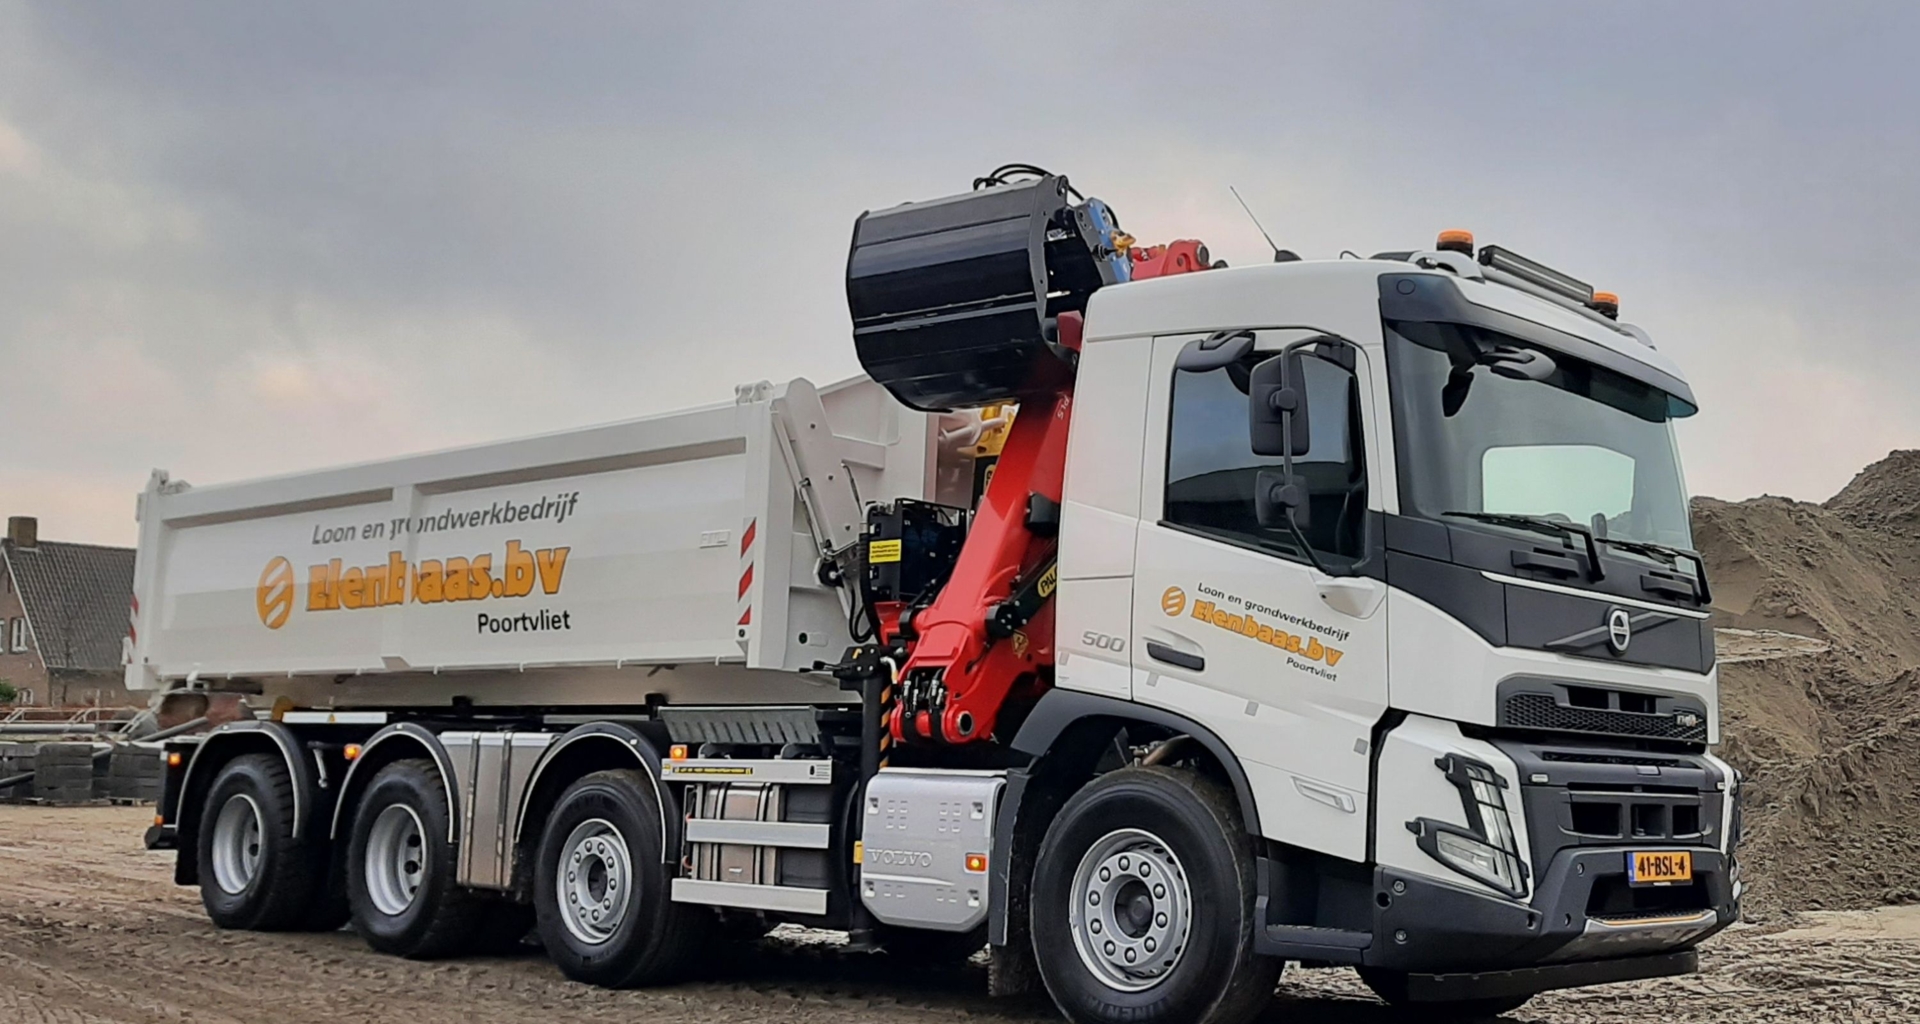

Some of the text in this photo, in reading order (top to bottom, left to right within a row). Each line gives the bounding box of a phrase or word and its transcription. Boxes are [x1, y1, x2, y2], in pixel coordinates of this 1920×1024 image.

[312, 525, 356, 545] Loon
[361, 522, 385, 540] en
[477, 610, 571, 634] Poortvliet
[1198, 582, 1350, 642] Loon en grondwerkbedrijf
[1082, 630, 1126, 652] 500
[1190, 598, 1345, 667] Elenbaas.bv
[1286, 656, 1338, 682] Poortvliet
[866, 848, 932, 867] VOLVO
[1638, 855, 1686, 877] 41-BSL-4
